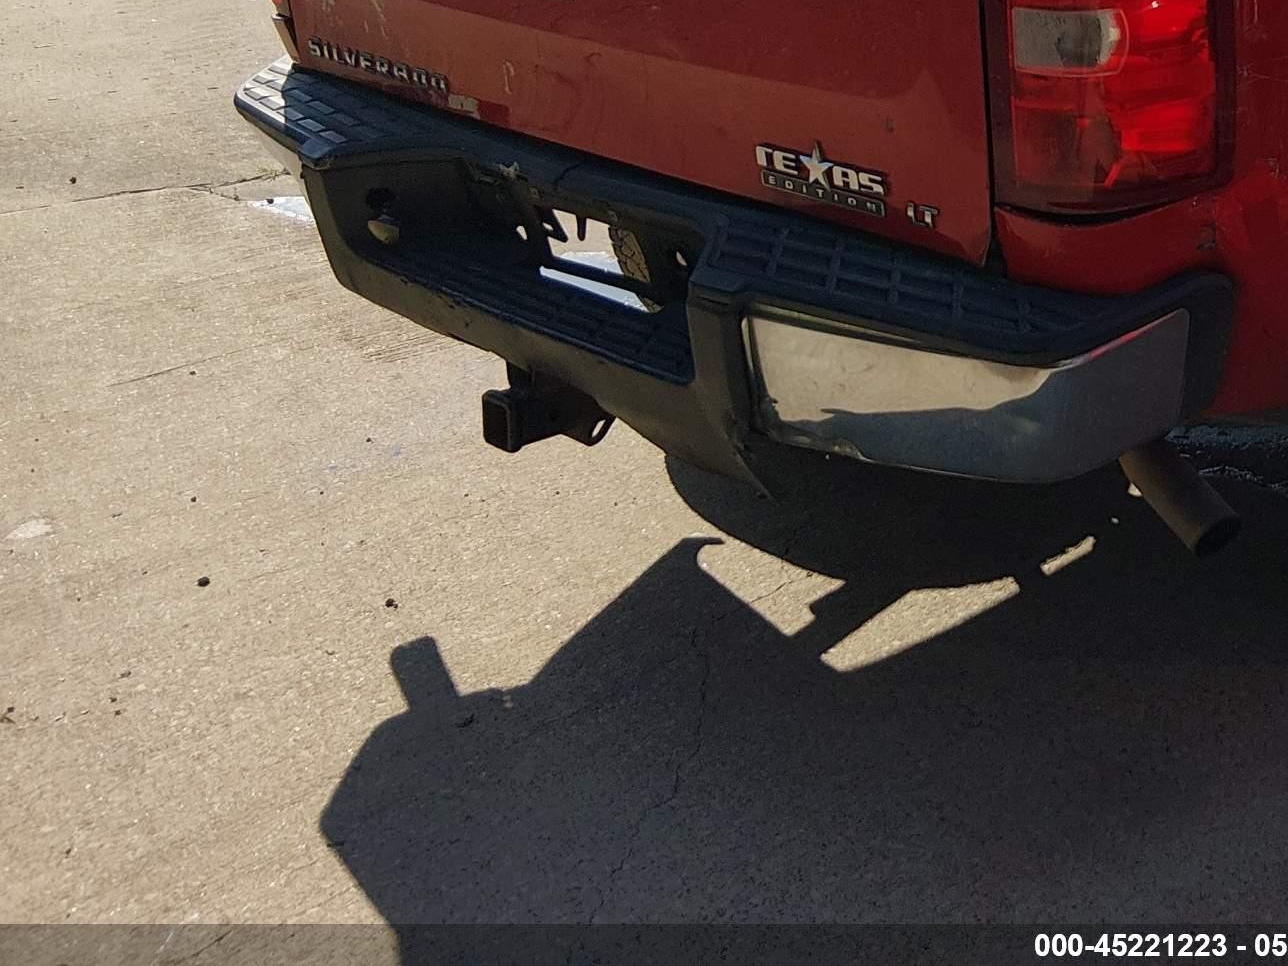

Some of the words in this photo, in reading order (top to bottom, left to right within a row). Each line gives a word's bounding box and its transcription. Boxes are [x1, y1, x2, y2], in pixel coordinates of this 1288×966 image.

[308, 36, 448, 93] SILVERADO
[755, 139, 885, 195] TEXAS
[768, 175, 878, 212] EDITION
[907, 201, 940, 229] LT
